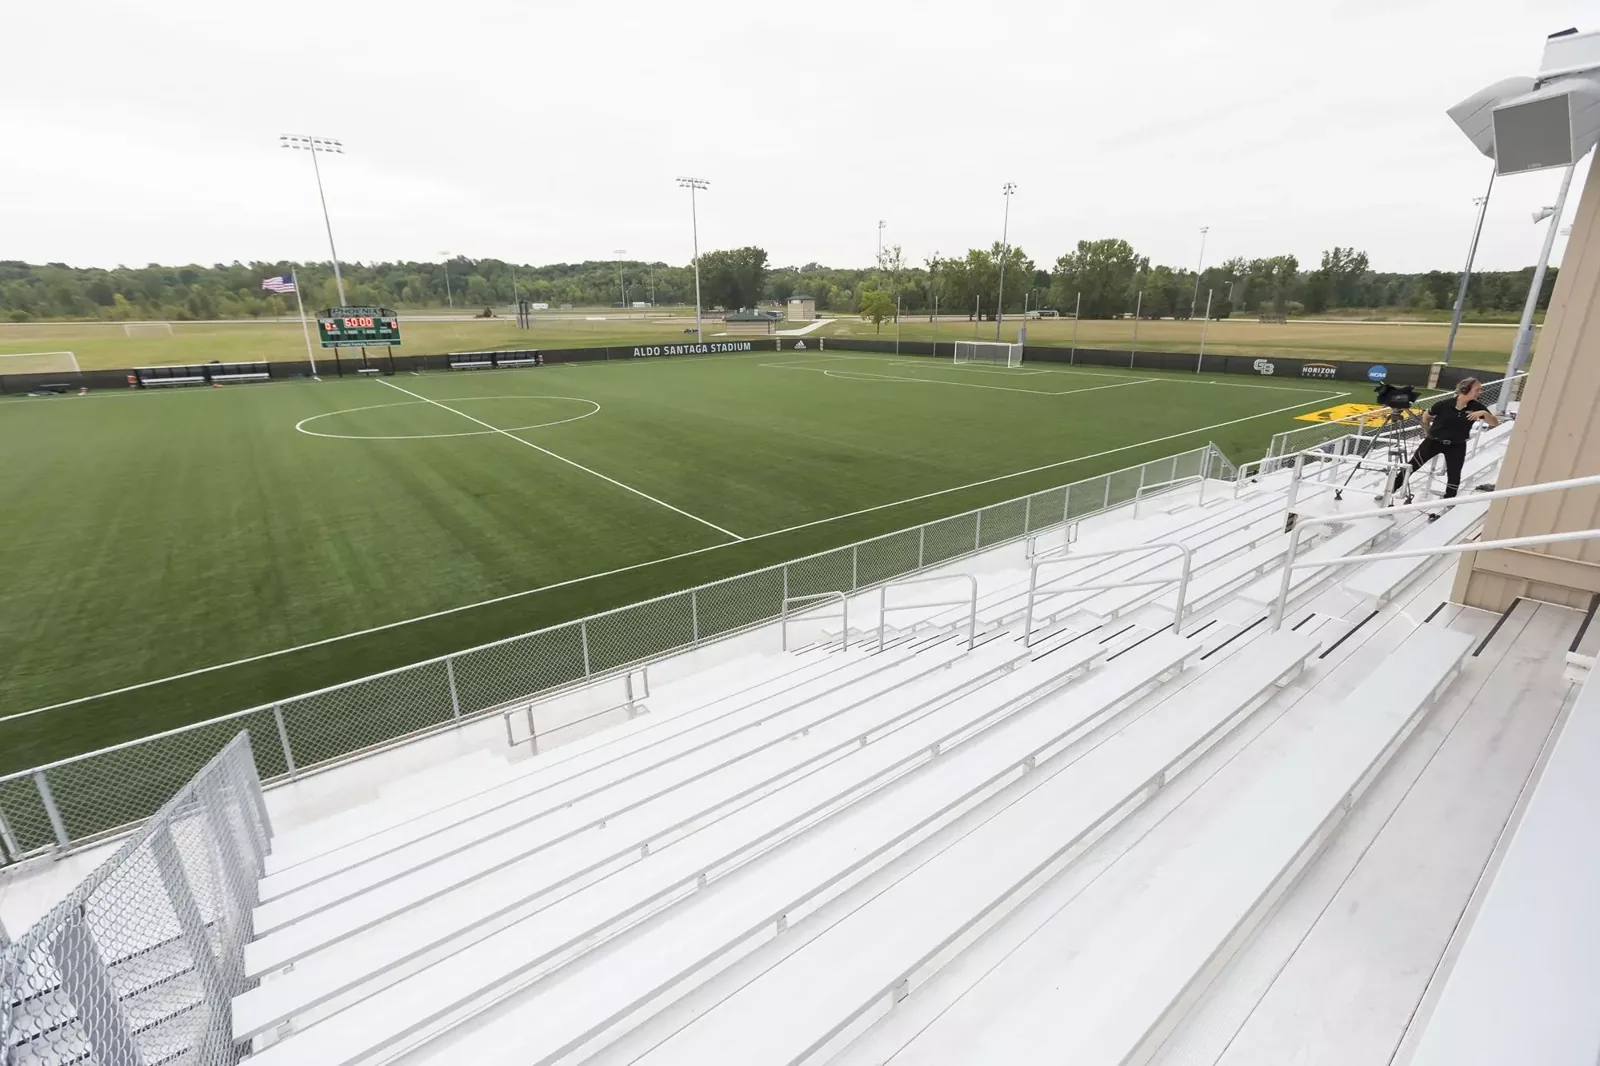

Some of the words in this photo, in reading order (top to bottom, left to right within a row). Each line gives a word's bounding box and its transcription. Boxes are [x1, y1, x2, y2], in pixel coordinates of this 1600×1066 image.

[633, 346, 660, 357] ALDO
[663, 344, 708, 355] SANTAGA
[710, 342, 751, 353] STADIUM
[1302, 366, 1336, 374] HORIZON
